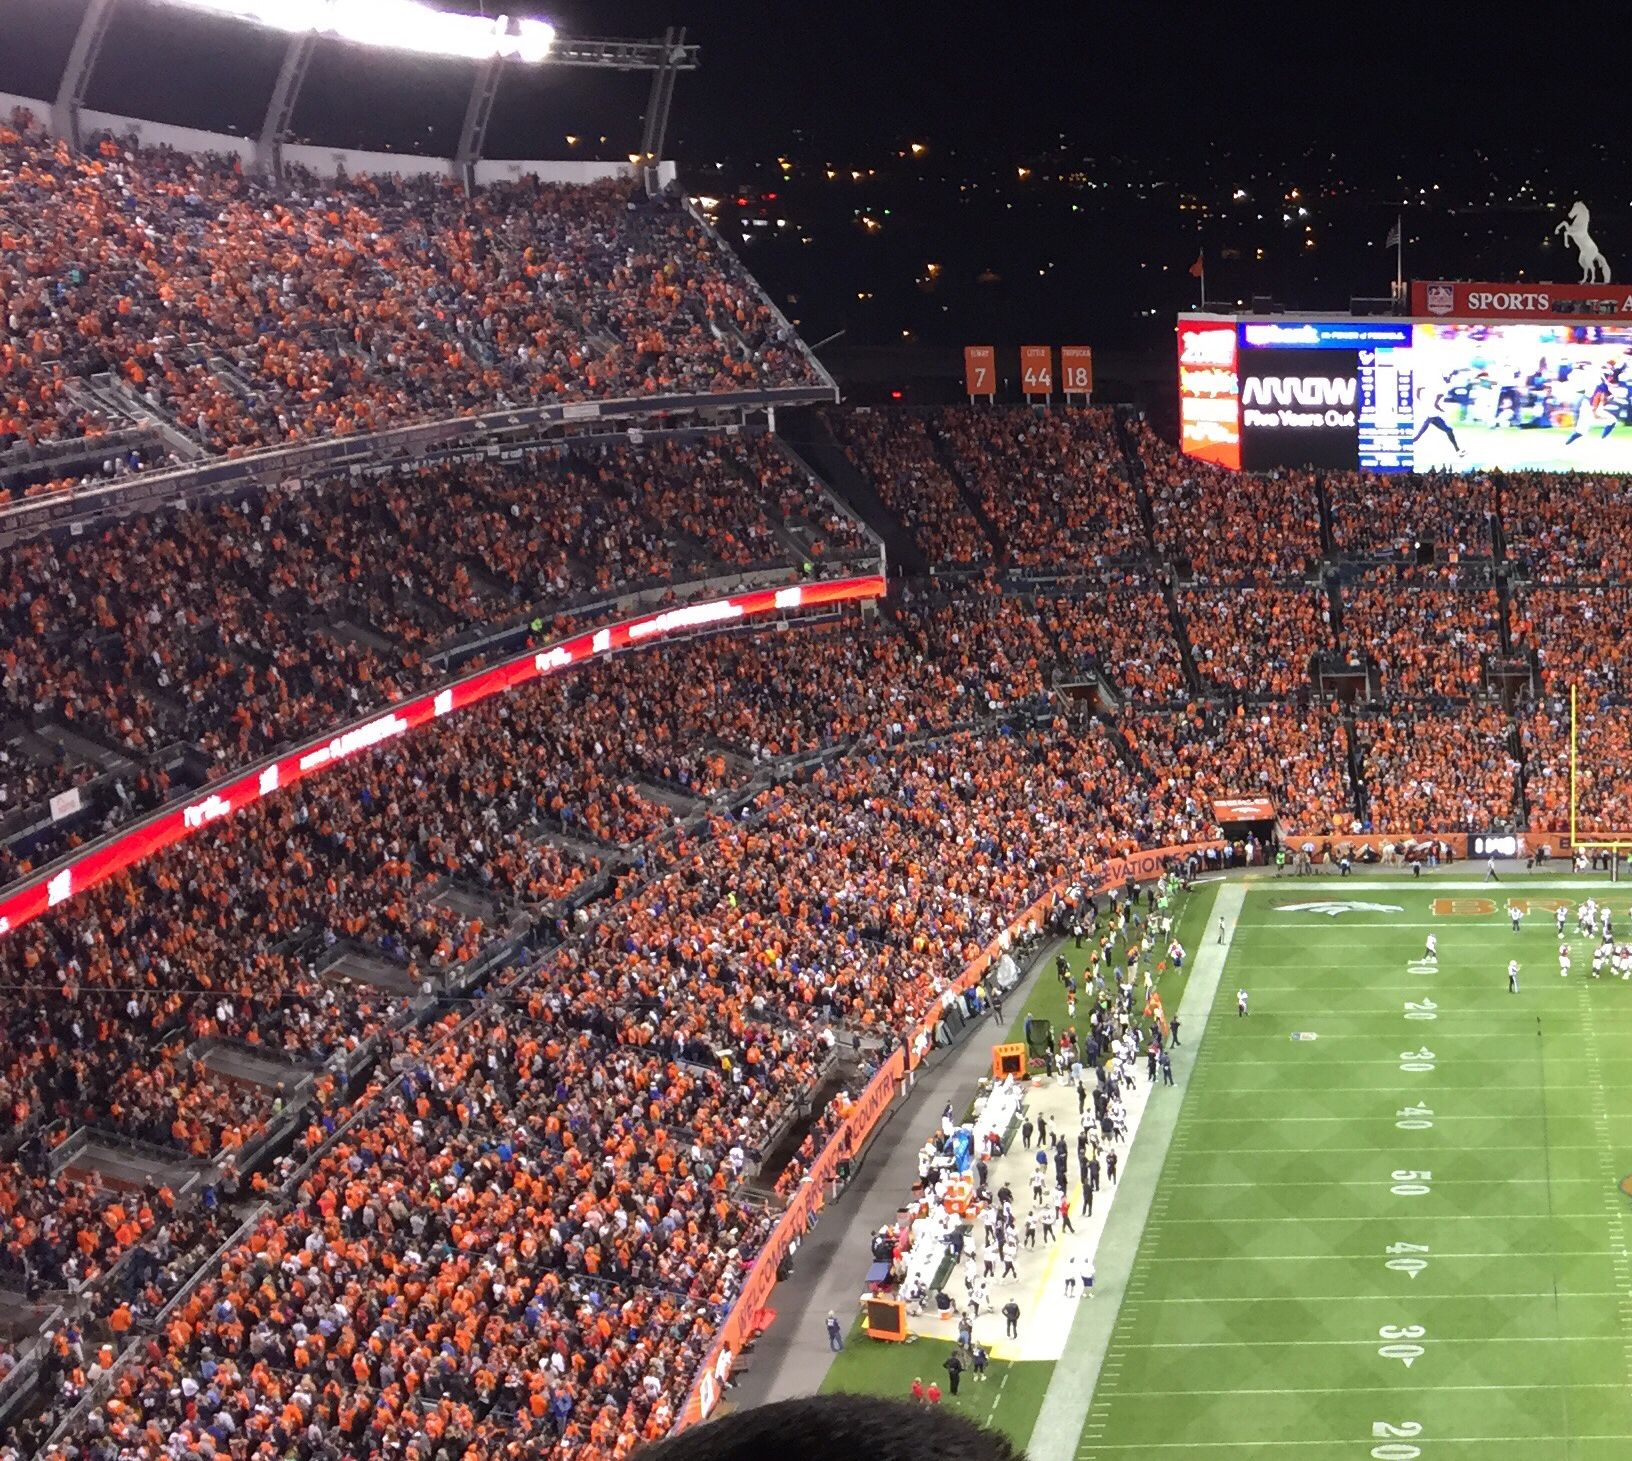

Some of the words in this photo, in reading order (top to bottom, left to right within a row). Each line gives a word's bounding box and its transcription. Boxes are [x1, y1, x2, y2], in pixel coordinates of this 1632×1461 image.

[1468, 293, 1549, 310] SPORTS
[974, 367, 987, 387] 7
[1024, 367, 1050, 387] 44
[1067, 367, 1088, 387] 18
[1242, 377, 1357, 405] ARROW
[1243, 410, 1279, 427] Five
[1279, 410, 1324, 427] Years
[1324, 410, 1355, 427] Out
[1404, 1001, 1438, 1020] 20
[1400, 1051, 1435, 1072] 30
[1395, 1107, 1434, 1129] 40
[1390, 1169, 1432, 1196] 50
[1384, 1241, 1429, 1270] 40
[1377, 1324, 1426, 1358] 30
[1370, 1421, 1423, 1461] 20
